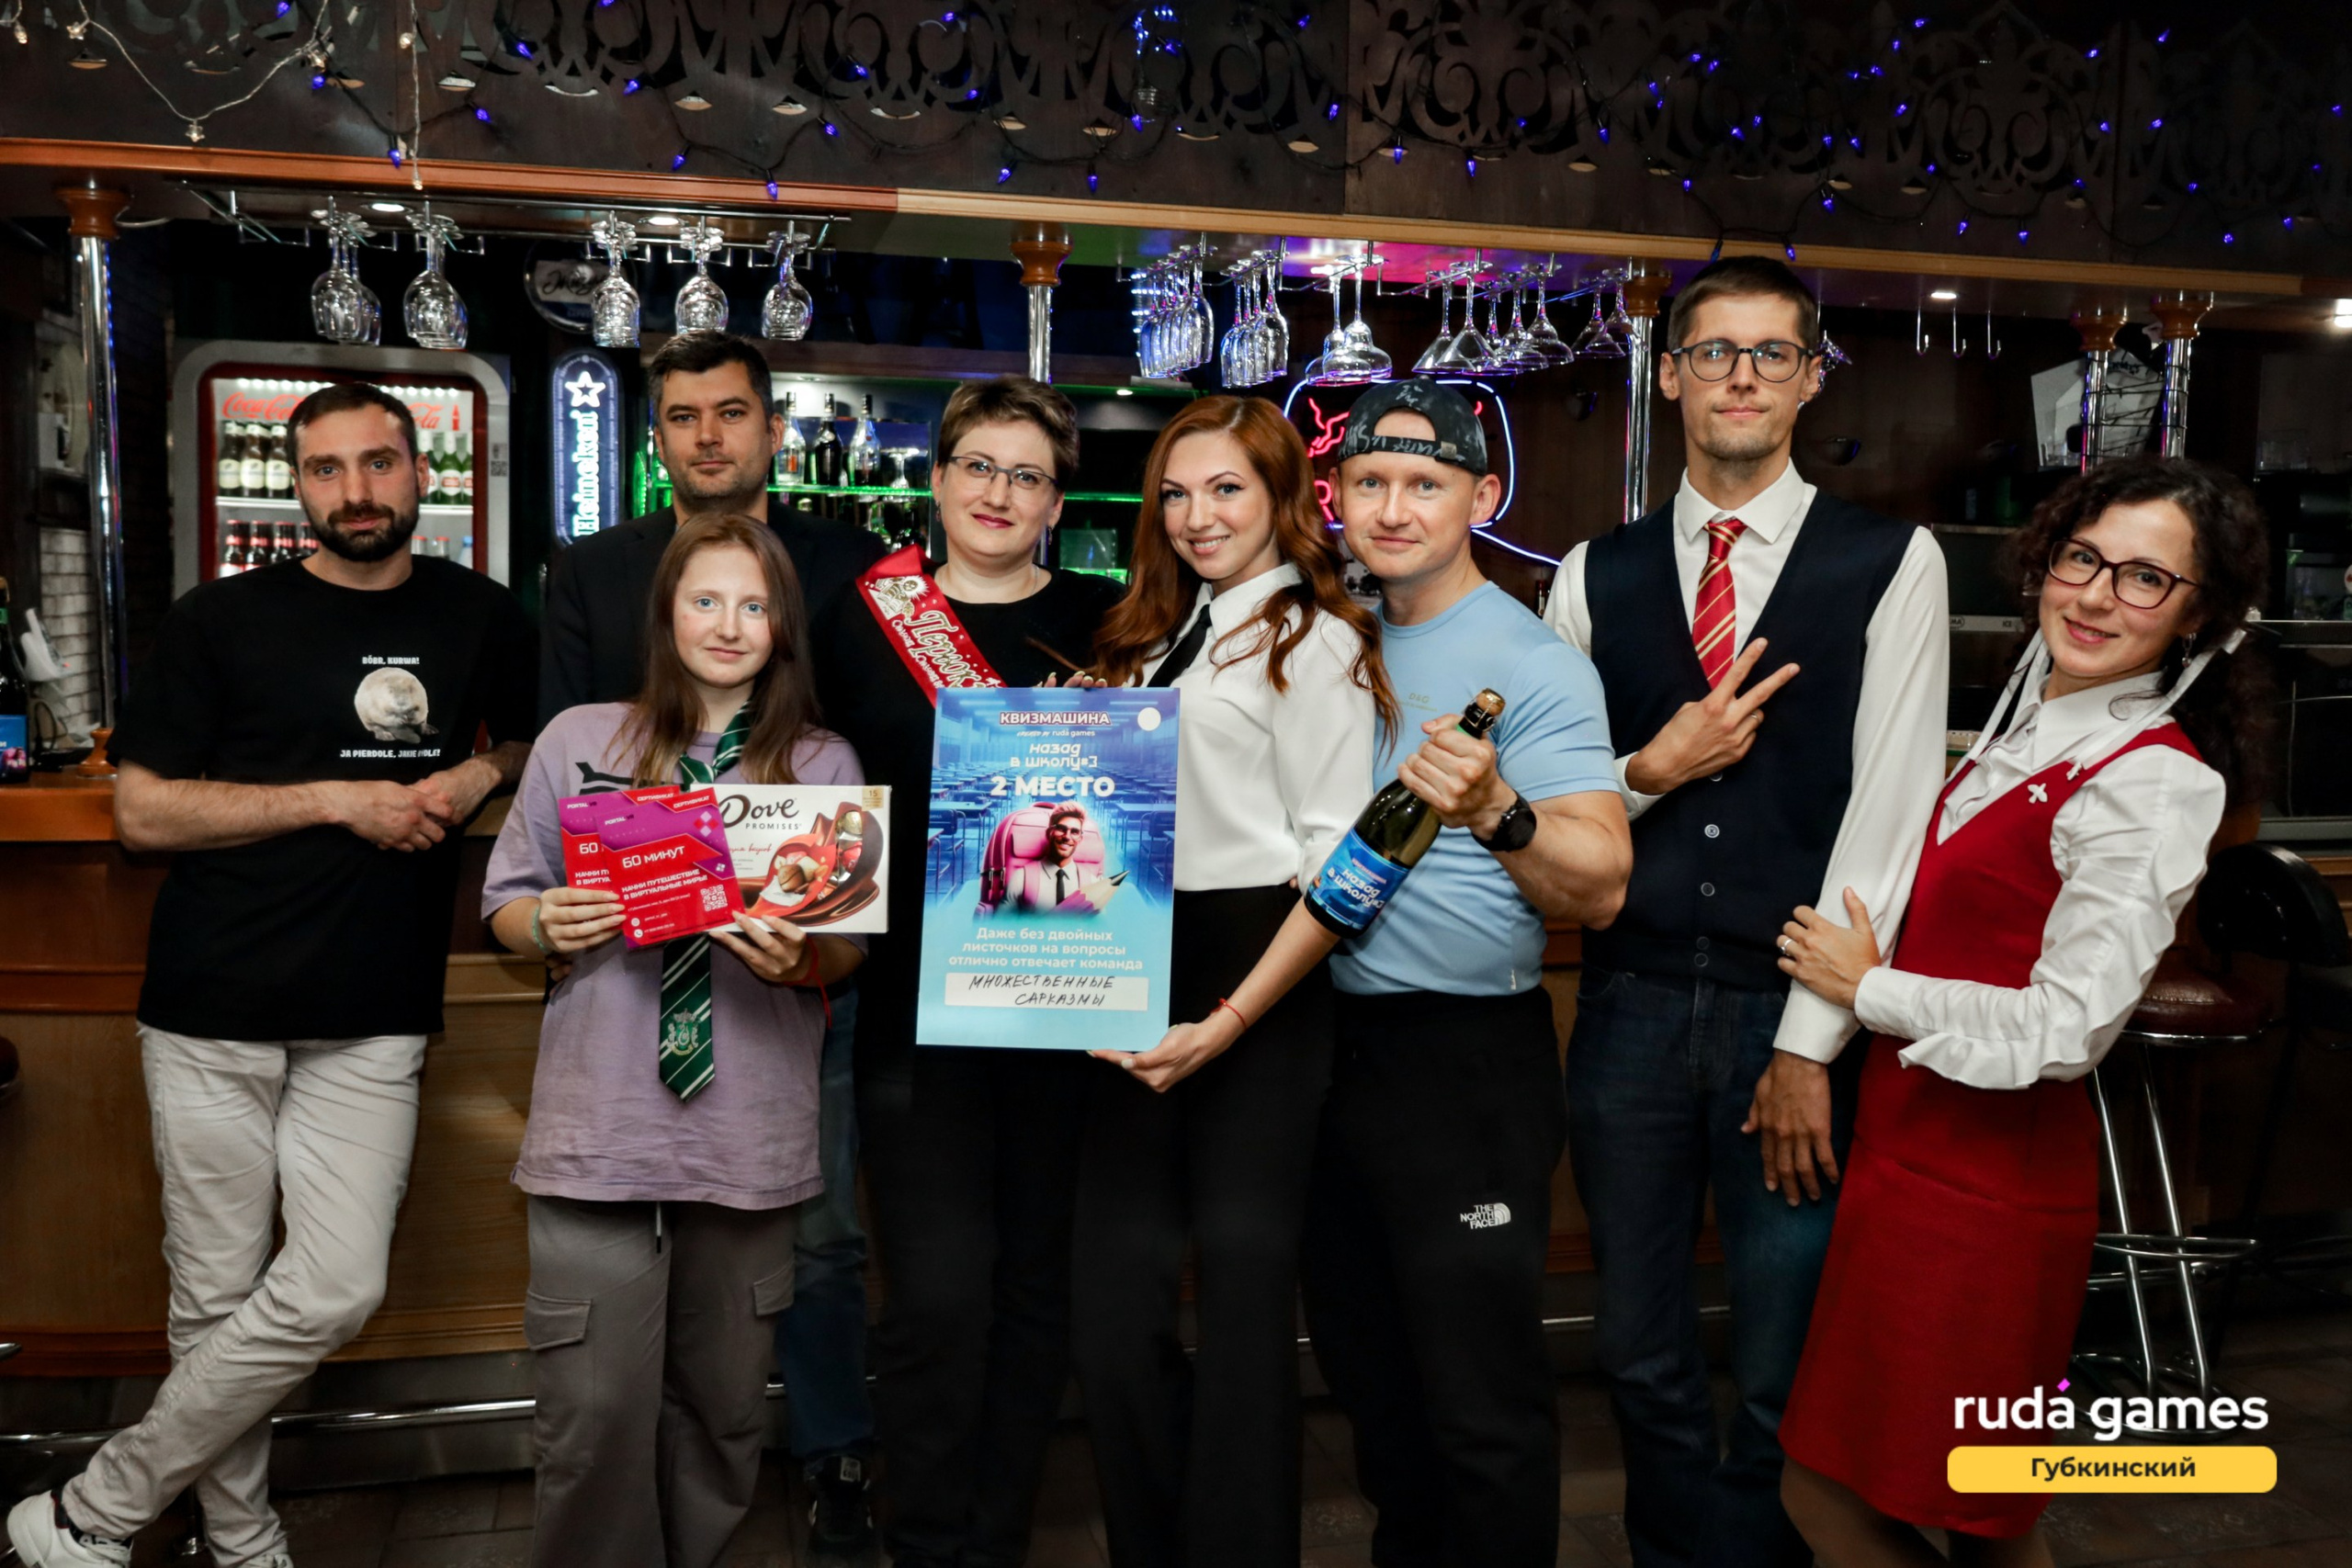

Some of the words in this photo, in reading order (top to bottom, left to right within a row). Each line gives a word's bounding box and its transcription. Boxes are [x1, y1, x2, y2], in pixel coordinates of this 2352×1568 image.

[570, 410, 600, 537] Heineken
[904, 610, 986, 688] Первок
[1000, 712, 1111, 725] КВИЗМАШИНА
[340, 750, 352, 758] JA
[1029, 743, 1081, 757] назад
[990, 776, 1008, 796] 2
[1014, 776, 1115, 797] МЕСТО
[718, 795, 799, 829] Dove
[605, 817, 626, 826] PORTAL
[579, 841, 599, 854] 60
[622, 854, 642, 869] 60
[582, 874, 612, 885] ВИРТУА
[621, 880, 647, 893] НАЧНИ
[647, 869, 701, 887] ПУТЕШЕСТВИЕ
[629, 880, 683, 899] ВИРТУАЛЬНЫЕ
[976, 927, 1016, 941] Даже
[1020, 928, 1045, 940] без
[1047, 929, 1114, 942] двойных
[962, 942, 1038, 953] листочков
[1042, 944, 1058, 953] на
[1062, 944, 1126, 956] вопросы
[948, 955, 1008, 966] отлично
[1012, 957, 1076, 968] отвечает
[1080, 958, 1143, 971] команда
[968, 975, 1115, 990] МНОЖЕСТВЕННЫЕ
[1014, 992, 1105, 1007] САРКАЗМЫ
[1473, 1204, 1494, 1213] THE
[1460, 1211, 1495, 1223] NORTH
[1470, 1219, 1495, 1229] FACE
